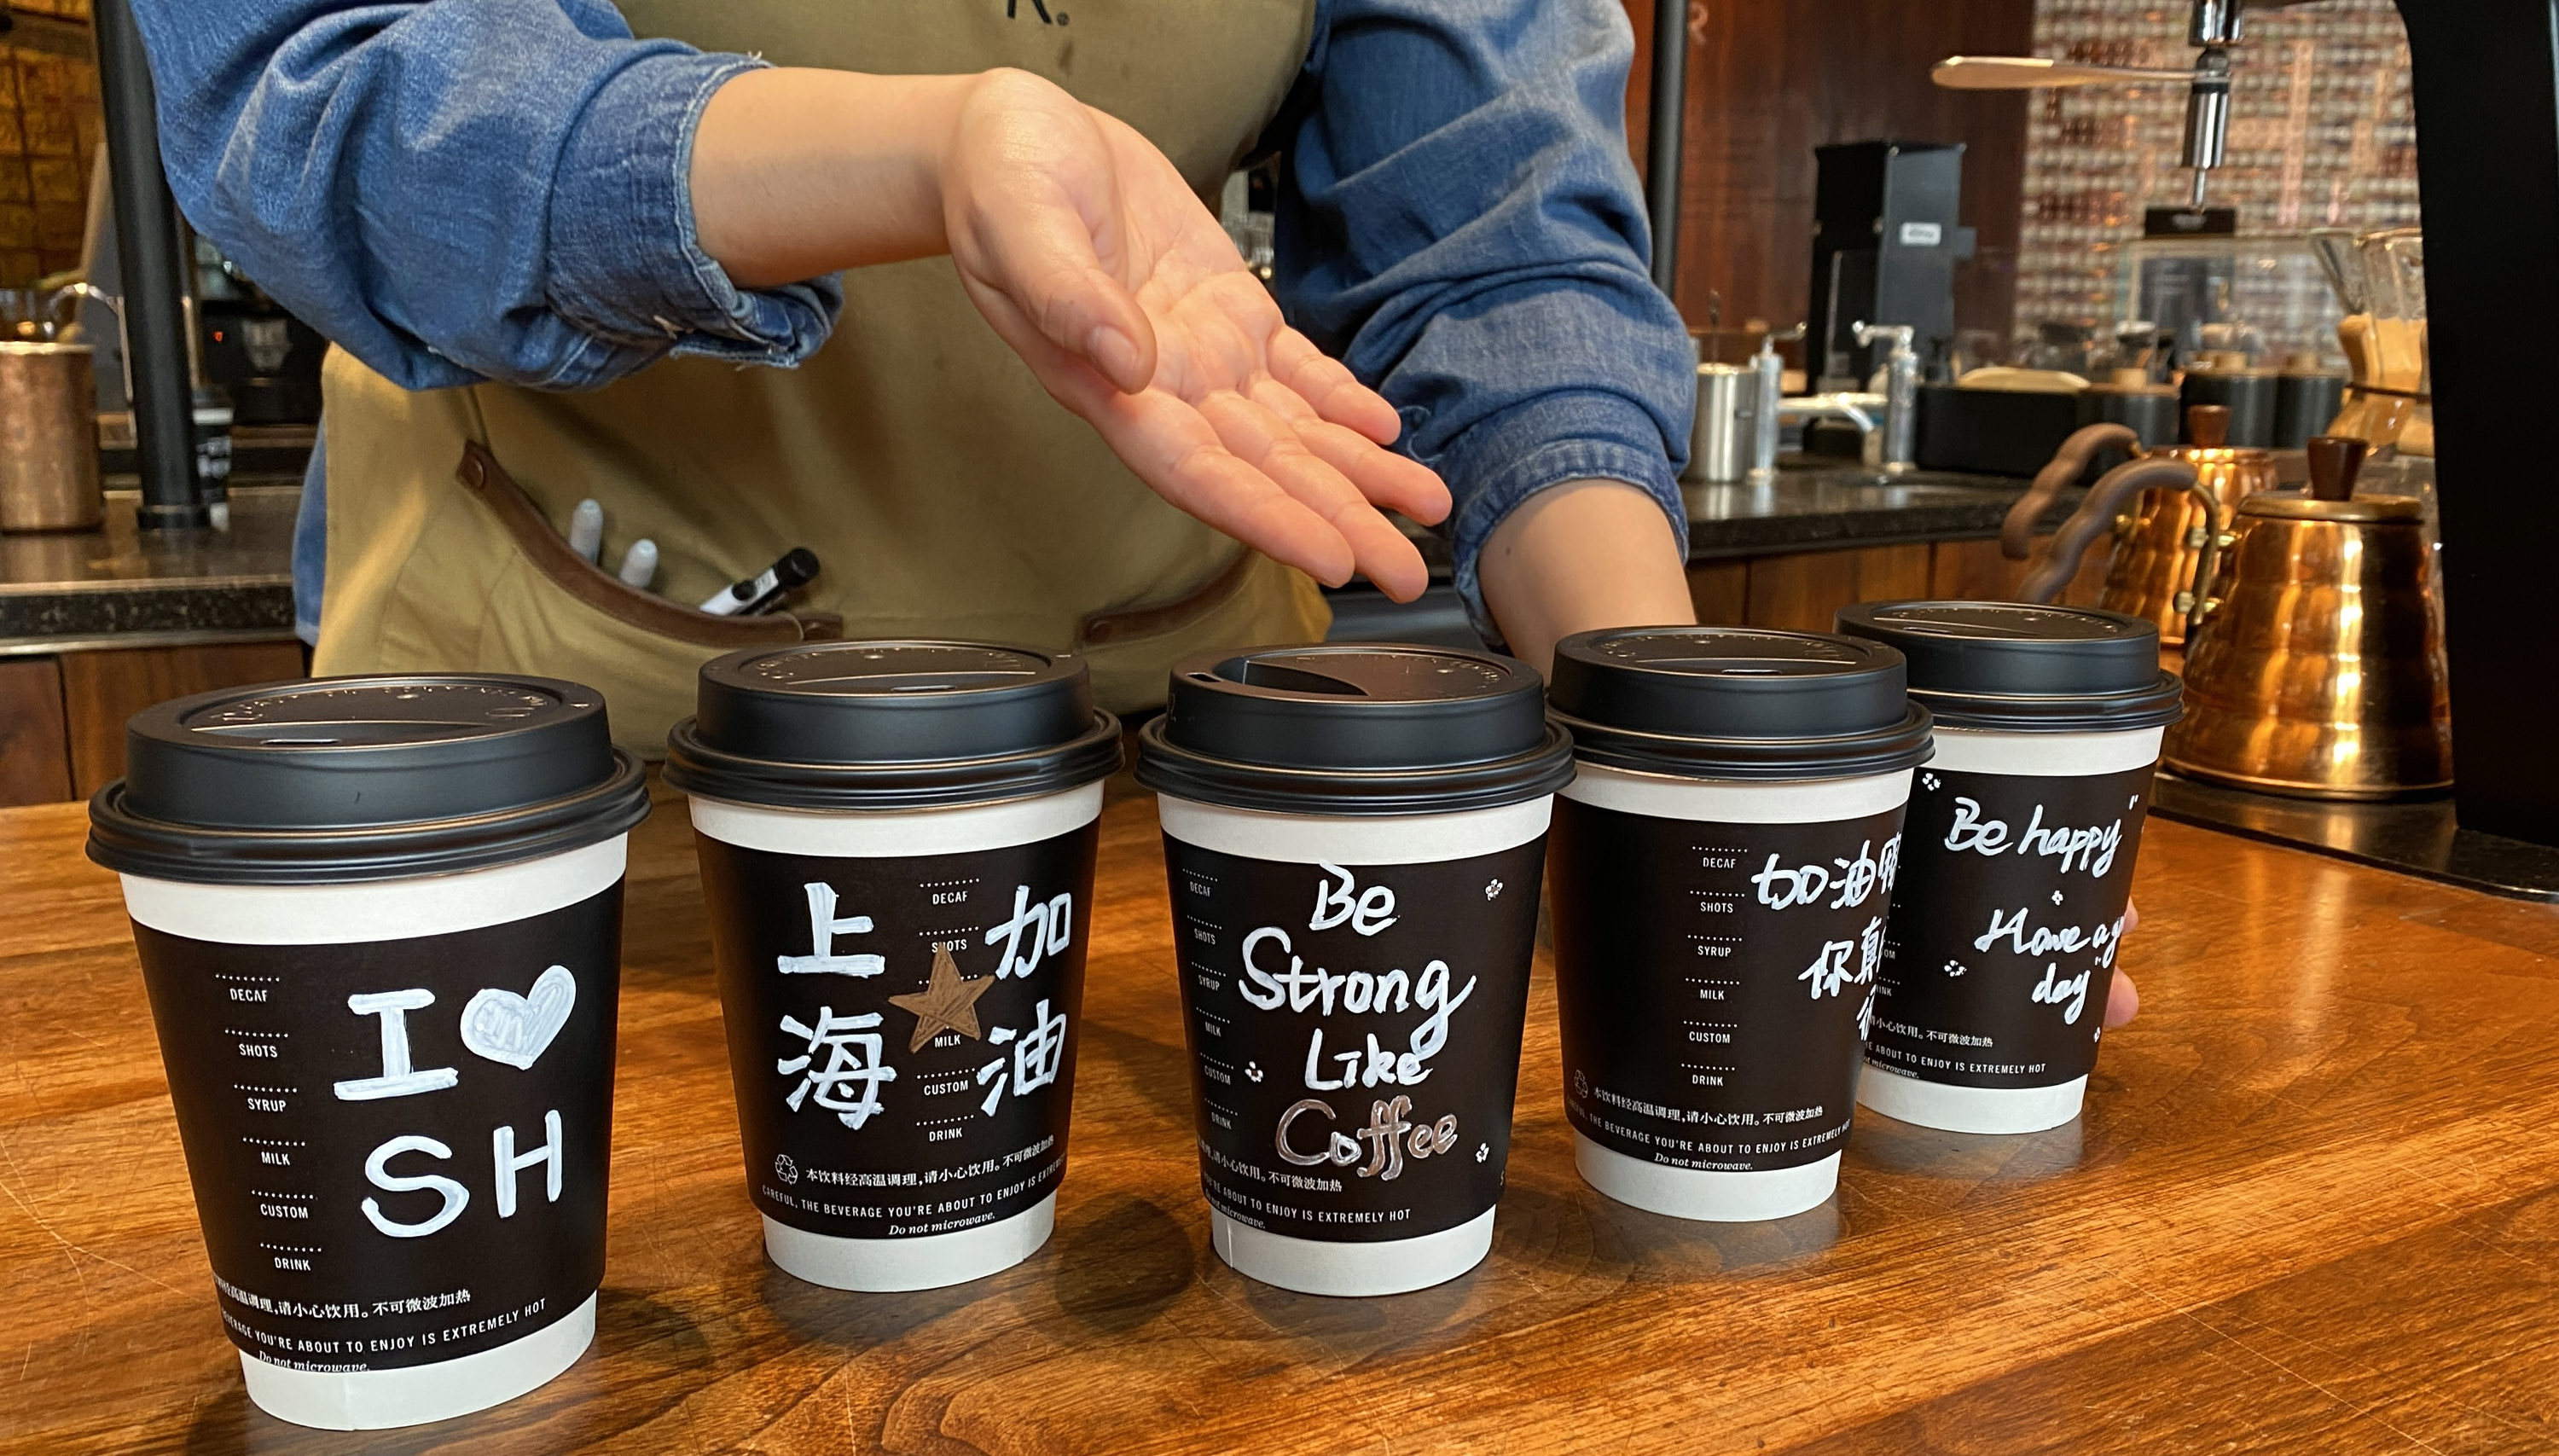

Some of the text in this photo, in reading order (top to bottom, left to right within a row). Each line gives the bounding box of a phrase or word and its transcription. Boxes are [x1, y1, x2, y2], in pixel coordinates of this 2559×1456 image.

[1944, 797, 2123, 878] Be happy
[1703, 857, 1736, 869] DECAF
[932, 891, 968, 905] DECAF
[1189, 881, 1211, 897] DECAF
[1309, 859, 1401, 936] Be
[1700, 902, 1733, 914] SHOTS
[1193, 928, 1216, 946] SHOTS
[1697, 946, 1732, 958] SYRUP
[1798, 916, 1886, 1000] 你真
[1198, 974, 1220, 992] SYRUP
[229, 987, 268, 1003] DECAF
[1238, 925, 1477, 1061] Strong
[1700, 989, 1725, 1001] MILK
[2032, 963, 2092, 1024] day
[1204, 1021, 1221, 1037] MILK
[1689, 1031, 1731, 1044] CUSTOM
[334, 989, 459, 1101] I
[934, 1034, 961, 1048] MILK
[239, 1043, 278, 1059] SHOTS
[1304, 1028, 1433, 1091] Like
[1876, 1044, 1901, 1060] ABOUT
[1906, 1053, 1917, 1064] TO
[1921, 1056, 1951, 1070] ENJOY
[1955, 1061, 1965, 1071] IS
[1970, 1063, 2025, 1074] EXTREMELY
[2028, 1063, 2046, 1074] HOT
[1204, 1064, 1232, 1086] CUSTOM
[1871, 1058, 1919, 1079] microwave.
[924, 1081, 969, 1096] CUSTOM
[1691, 1075, 1724, 1087] DRINK
[247, 1098, 286, 1113] SYRUP
[1210, 1111, 1232, 1130] DRINK
[929, 1128, 963, 1142] DRINK
[1274, 1094, 1459, 1181] Coffee
[1590, 1113, 1602, 1128] THE
[1604, 1121, 1650, 1144] BEVERAGE
[1655, 1135, 1692, 1151] YOU'RE
[1698, 1142, 1733, 1154] ABOUT
[1738, 1144, 1751, 1154] TO
[1756, 1142, 1786, 1154] ENJOY
[1790, 1140, 1799, 1151] IS
[1802, 1127, 1841, 1148] EXTREMELY
[261, 1151, 291, 1167] MILK
[1655, 1152, 1753, 1170] Do not microwave.
[361, 1110, 563, 1238] SH
[762, 1185, 798, 1209] CAREFUL,
[801, 1198, 820, 1213] THE
[824, 1204, 883, 1218] BEVERAGE
[888, 1204, 932, 1218] YOU'RE
[938, 1197, 975, 1213] ABOUT
[980, 1192, 993, 1204] TO
[997, 1181, 1024, 1200] ENJOY
[1028, 1175, 1036, 1188] IS
[1223, 1186, 1247, 1206] ABOUT
[1250, 1198, 1262, 1210] TO
[1266, 1203, 1297, 1219] ENJOY
[1303, 1209, 1313, 1221] IS
[1319, 1211, 1384, 1224] EXTREMELY
[1390, 1209, 1411, 1221] HOT
[260, 1204, 309, 1220] CUSTOM
[1221, 1203, 1266, 1229] microwave.
[888, 1211, 995, 1235] Do not microwave.
[274, 1256, 311, 1272] DRINK
[255, 1331, 293, 1350] YOU'RE
[299, 1340, 339, 1354] ABOUT
[346, 1341, 363, 1354] TO
[370, 1336, 415, 1352] ENJOY
[422, 1332, 436, 1346] IS
[444, 1310, 519, 1342] EXTREMELY
[525, 1298, 546, 1317] HOT
[258, 1350, 272, 1364] Do
[273, 1357, 292, 1369] not
